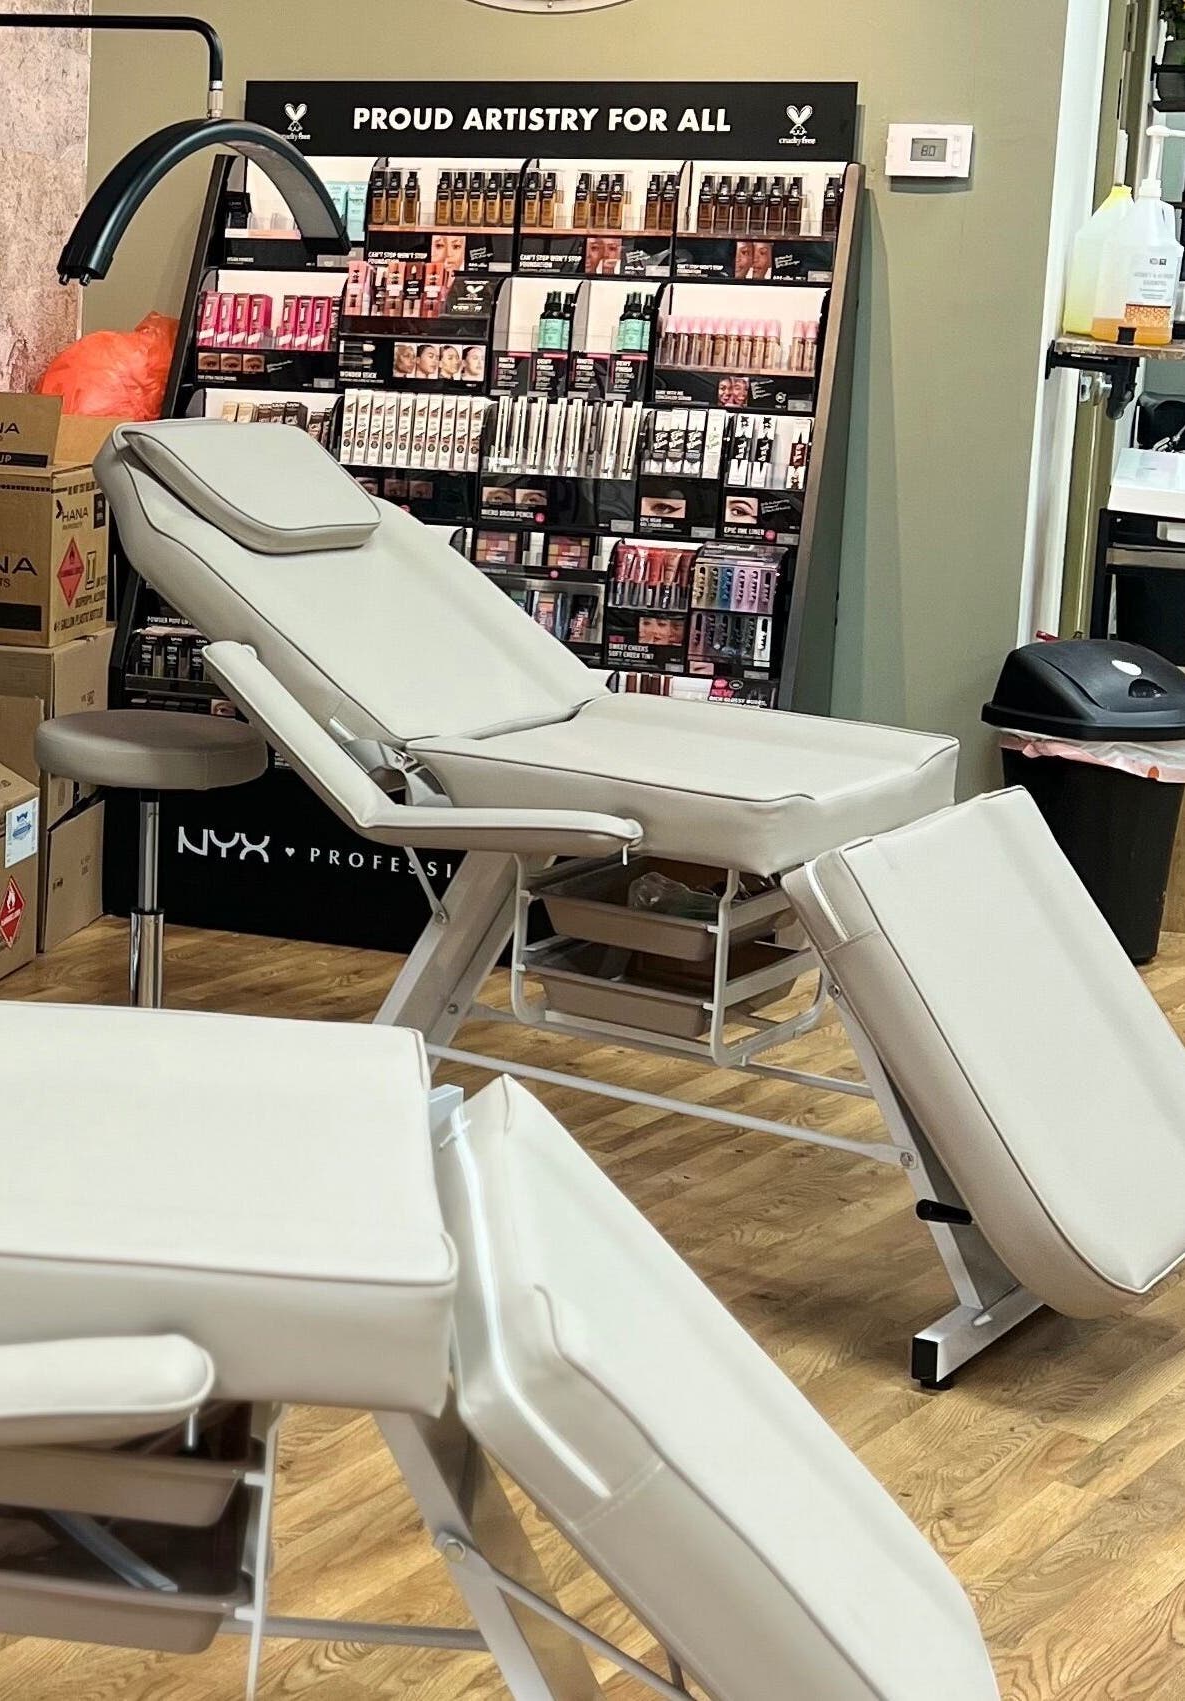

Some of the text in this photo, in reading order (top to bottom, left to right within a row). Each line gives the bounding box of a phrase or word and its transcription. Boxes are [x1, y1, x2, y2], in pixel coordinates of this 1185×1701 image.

[353, 107, 731, 132] PROUD ARTISTRY FOR ALL
[61, 506, 89, 522] HANA
[177, 825, 452, 878] NYX PROFESSI
